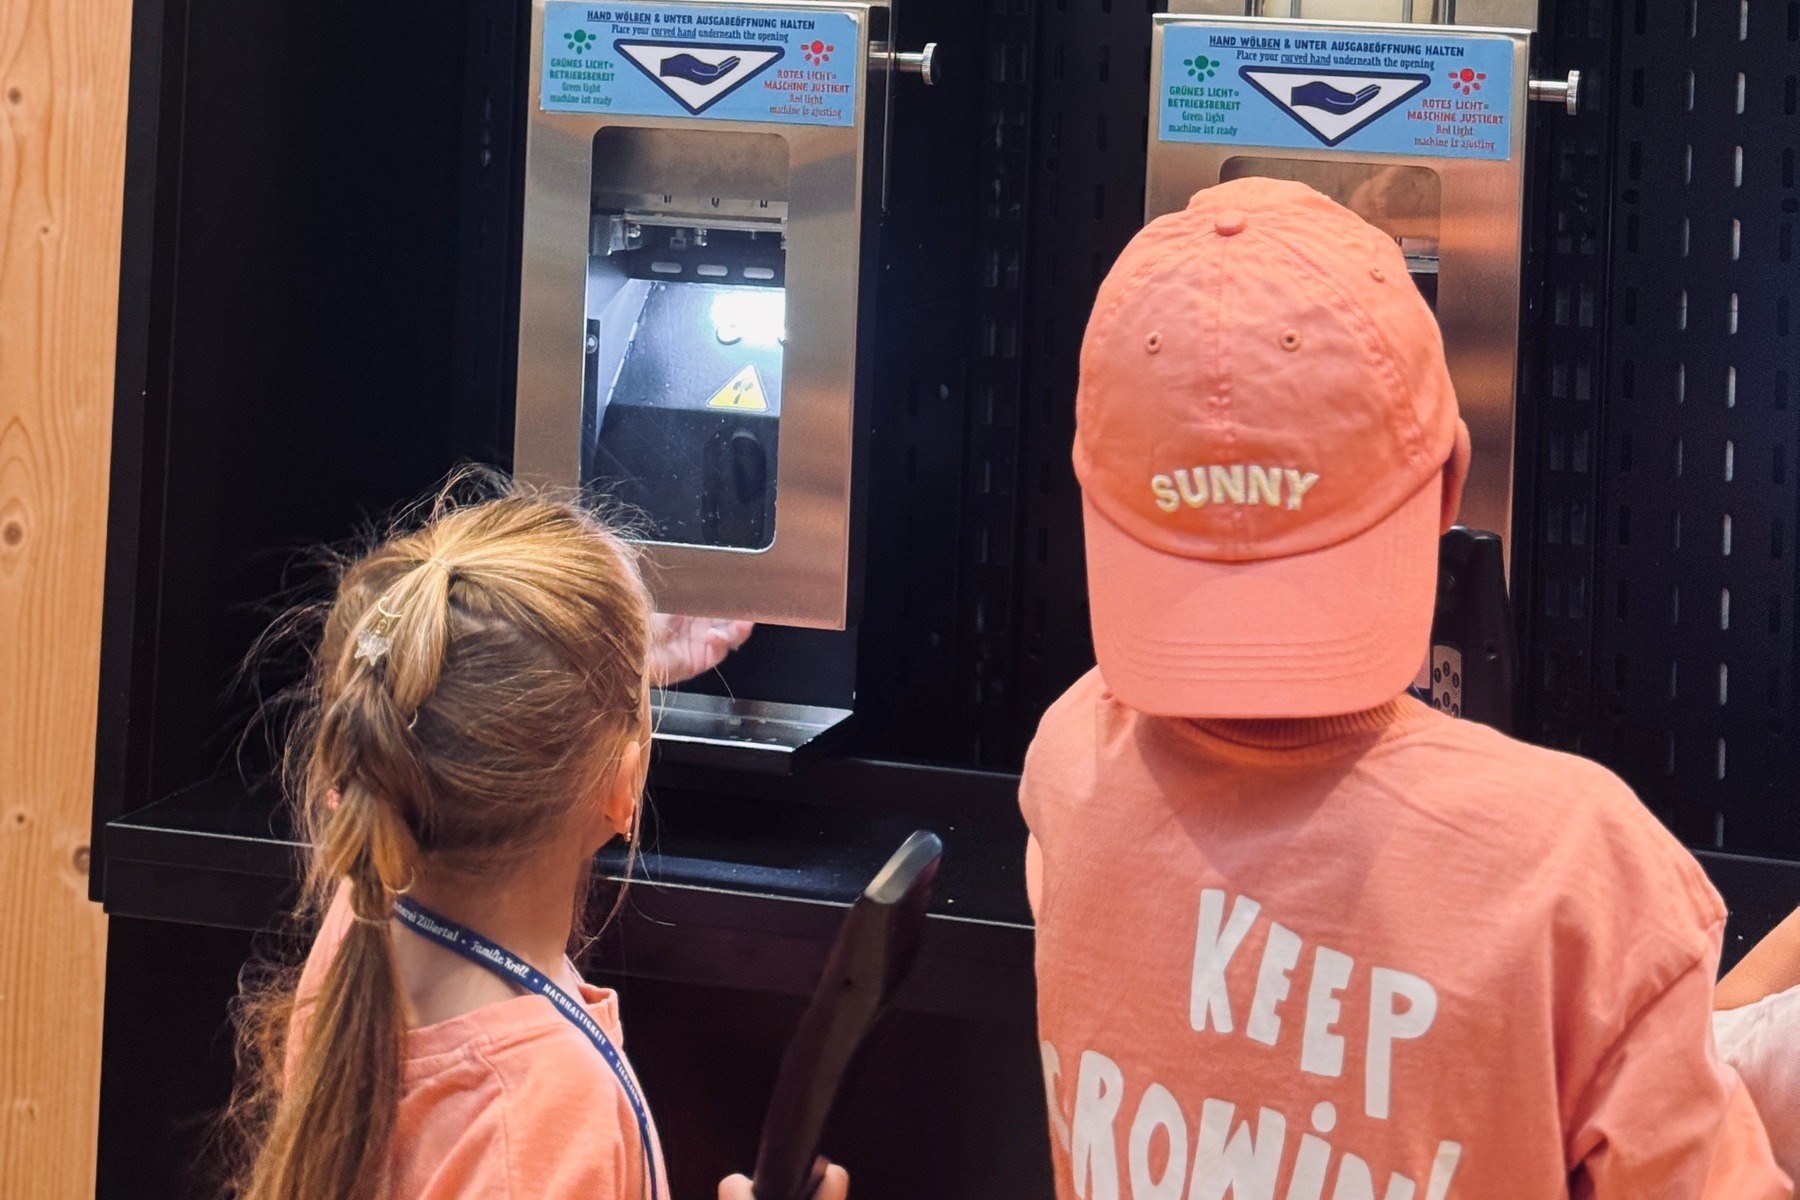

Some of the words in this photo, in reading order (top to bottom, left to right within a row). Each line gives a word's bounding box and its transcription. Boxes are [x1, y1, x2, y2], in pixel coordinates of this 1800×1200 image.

[587, 10, 612, 21] HAND
[615, 10, 650, 22] WÖLBEN
[654, 14, 660, 24] &
[664, 14, 693, 24] UNTER
[696, 16, 777, 29] AUSGABEÖFFNUNG
[780, 20, 815, 30] HALTEN
[612, 24, 630, 34] Place
[632, 26, 649, 36] your
[651, 26, 675, 36] curved
[677, 27, 696, 38] hand
[698, 29, 741, 40] underneath
[744, 30, 756, 40] the
[758, 32, 788, 44] opening
[1209, 36, 1236, 46] HAND
[1240, 36, 1280, 48] WÖLBEN
[1284, 39, 1291, 49] &
[1294, 40, 1326, 50] UNTER
[1330, 41, 1422, 55] AUSGABEÖFFNUNG
[1426, 45, 1464, 57] HALTEN
[550, 58, 582, 68] GRÜNES
[1236, 50, 1258, 61] Place
[1260, 53, 1278, 62] your
[1280, 52, 1308, 64] curved
[1310, 54, 1330, 64] hand
[1333, 55, 1381, 67] underneath
[1384, 56, 1398, 67] the
[1400, 58, 1434, 70] opening
[549, 70, 615, 82] BETRIEBSBEREIT
[777, 69, 804, 80] ROTES
[562, 82, 581, 92] Green
[583, 82, 600, 94] light
[764, 80, 808, 92] MASCHINE
[811, 83, 850, 94] JUSTIERT
[1170, 85, 1204, 97] GRÜNES
[550, 94, 579, 104] machine
[593, 96, 612, 107] ready
[790, 94, 802, 103] Red
[804, 95, 822, 105] light
[1168, 99, 1241, 110] BETRIEBSBEREIT
[1422, 99, 1452, 110] ROTES
[770, 105, 800, 114] machine
[802, 106, 810, 116] is
[1182, 112, 1204, 122] Green
[1205, 112, 1225, 124] light
[1408, 111, 1456, 122] MASCHINE
[1460, 113, 1504, 124] JUSTIERT
[1168, 124, 1201, 134] machine
[1204, 124, 1214, 134] ist
[1216, 126, 1238, 136] ready
[1436, 124, 1450, 134] Red
[1452, 126, 1474, 136] light
[1414, 136, 1448, 147] machine
[1450, 138, 1458, 148] is
[1460, 139, 1495, 151] ajusting
[1151, 464, 1320, 512] SUNNY
[1189, 888, 1438, 1120] KEEP
[542, 983, 606, 1046] NACHHALTIGKEIT
